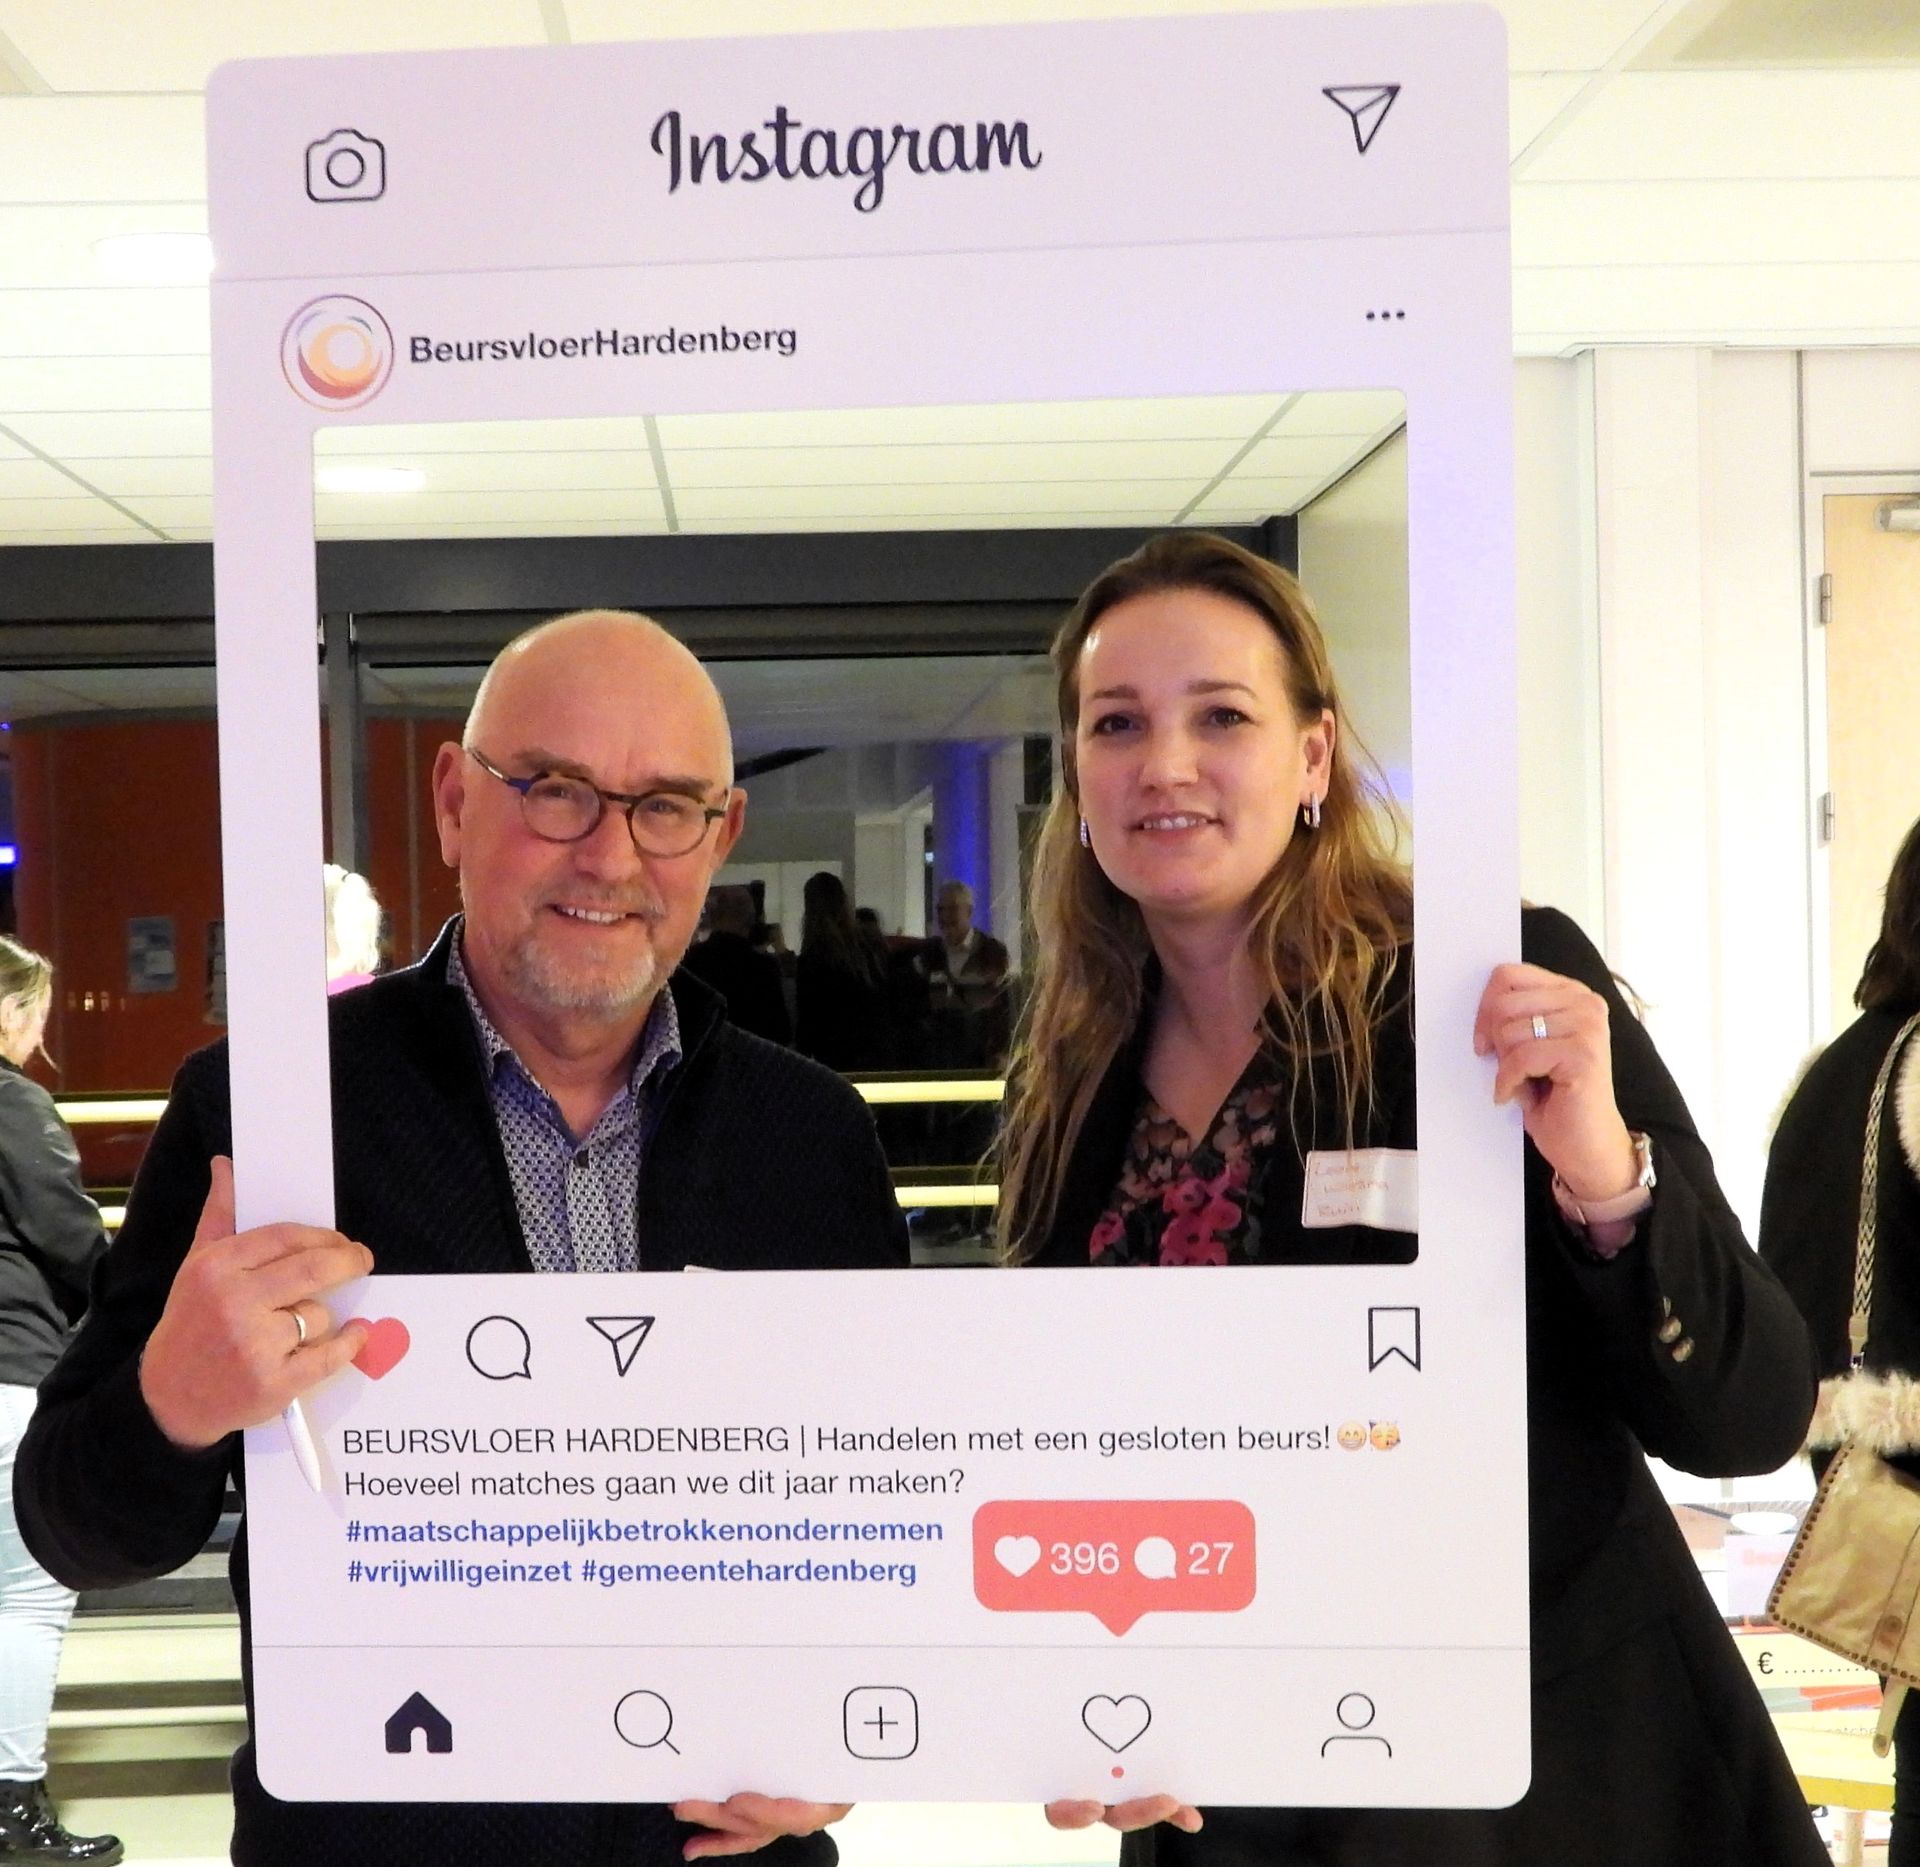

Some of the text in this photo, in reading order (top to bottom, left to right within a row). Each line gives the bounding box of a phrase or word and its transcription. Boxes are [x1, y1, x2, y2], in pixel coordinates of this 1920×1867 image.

[650, 105, 1042, 213] Instagram
[410, 325, 796, 364] BeursvloerHardenberg
[344, 1429, 555, 1454] BEURSVLOER
[567, 1427, 789, 1453] HARDENBERG
[818, 1426, 957, 1451] Handelen
[969, 1428, 1024, 1451] met
[1035, 1432, 1088, 1451] een
[1099, 1425, 1226, 1457] gesloten
[1238, 1425, 1330, 1451] beurs!
[345, 1468, 965, 1501] Hoeveel matches gaan we dit jaar maken?
[346, 1518, 944, 1547] #maatschappelijkbetrokkenondernemen
[347, 1559, 917, 1587] #vrijwilligeinzet #gemeentehardenberg
[1050, 1543, 1234, 1574] 396 27
[1757, 1652, 1774, 1675] €
